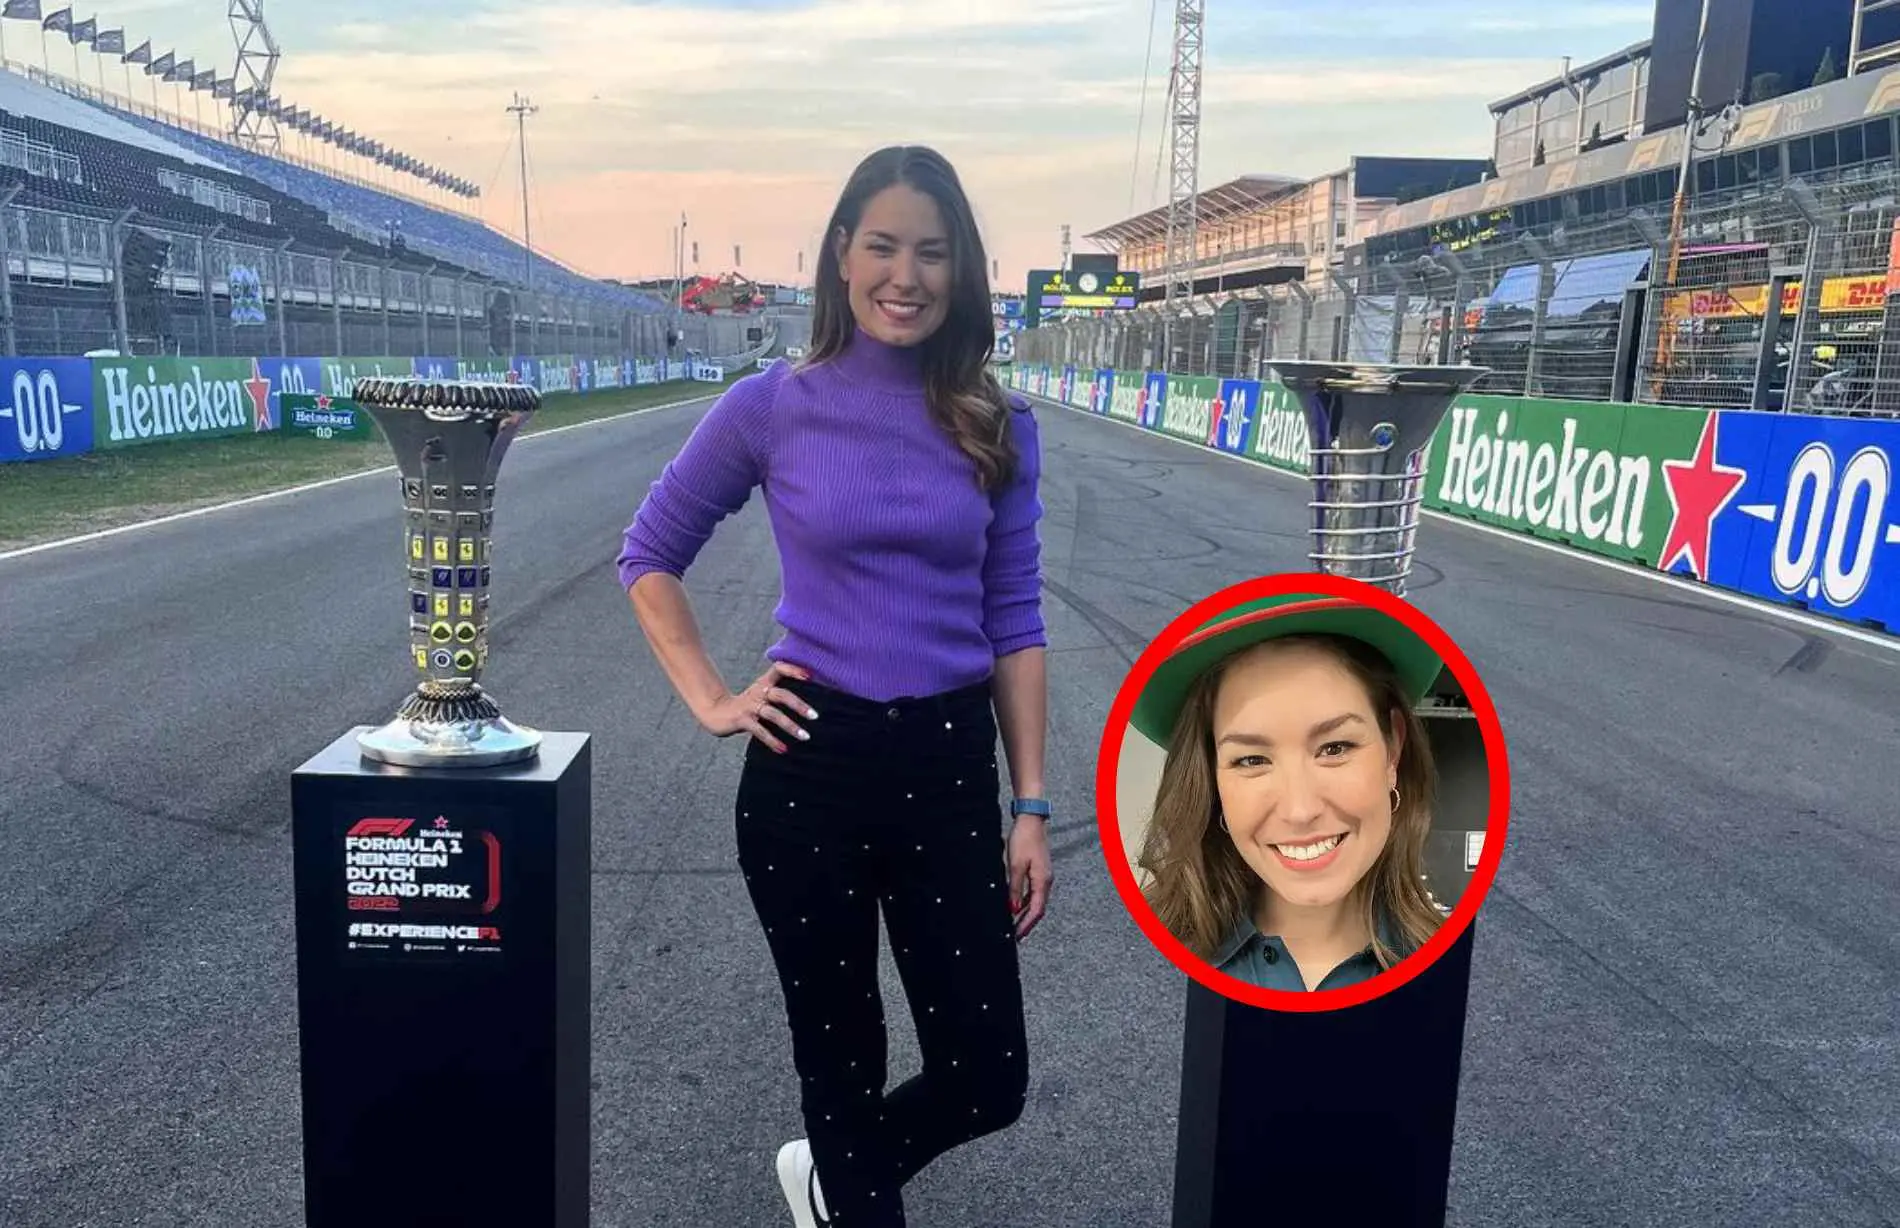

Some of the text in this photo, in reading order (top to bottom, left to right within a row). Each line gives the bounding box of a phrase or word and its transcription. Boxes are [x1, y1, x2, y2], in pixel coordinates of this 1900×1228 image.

[1847, 281, 1887, 305] DH
[13, 369, 63, 452] 0.0
[101, 366, 247, 440] Heineken
[295, 411, 352, 425] Heineken
[1255, 390, 1312, 467] Heine
[1438, 408, 1650, 549] Heineken
[1771, 441, 1890, 607] 0.0
[419, 829, 463, 838] Heineken
[346, 837, 463, 853] FORMULA 1
[346, 853, 448, 867] HEINEKEN
[346, 867, 415, 881] DUTCH
[347, 882, 472, 898] GRAND PRIX
[349, 923, 501, 939] #EXPERIENCEF1
